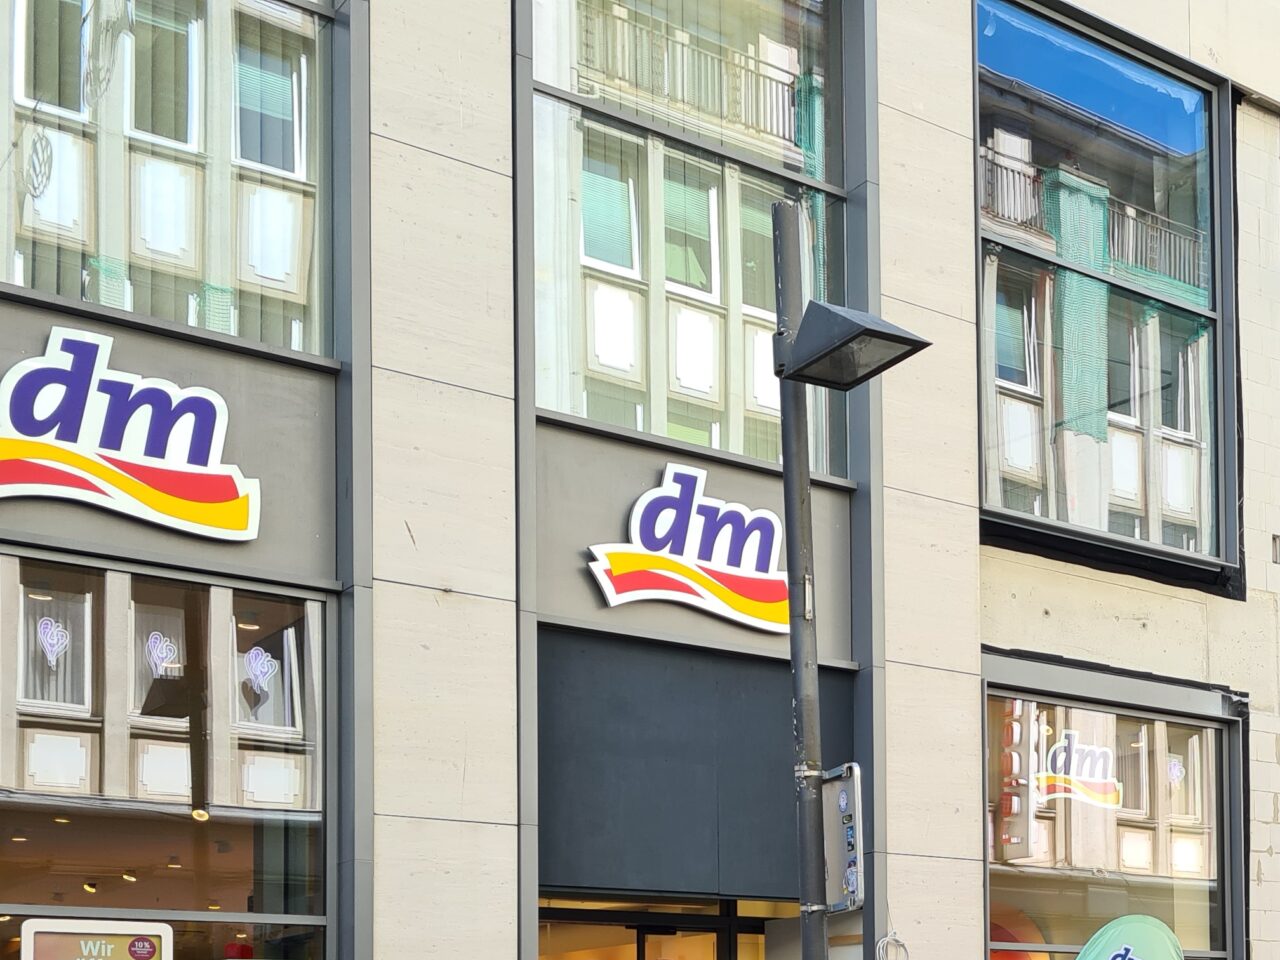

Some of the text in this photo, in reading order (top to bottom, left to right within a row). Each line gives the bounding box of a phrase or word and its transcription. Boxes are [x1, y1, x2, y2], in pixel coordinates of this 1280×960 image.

[9, 337, 217, 467] dm
[639, 471, 775, 574] dm
[1050, 733, 1110, 780] dm
[80, 940, 114, 957] Wir
